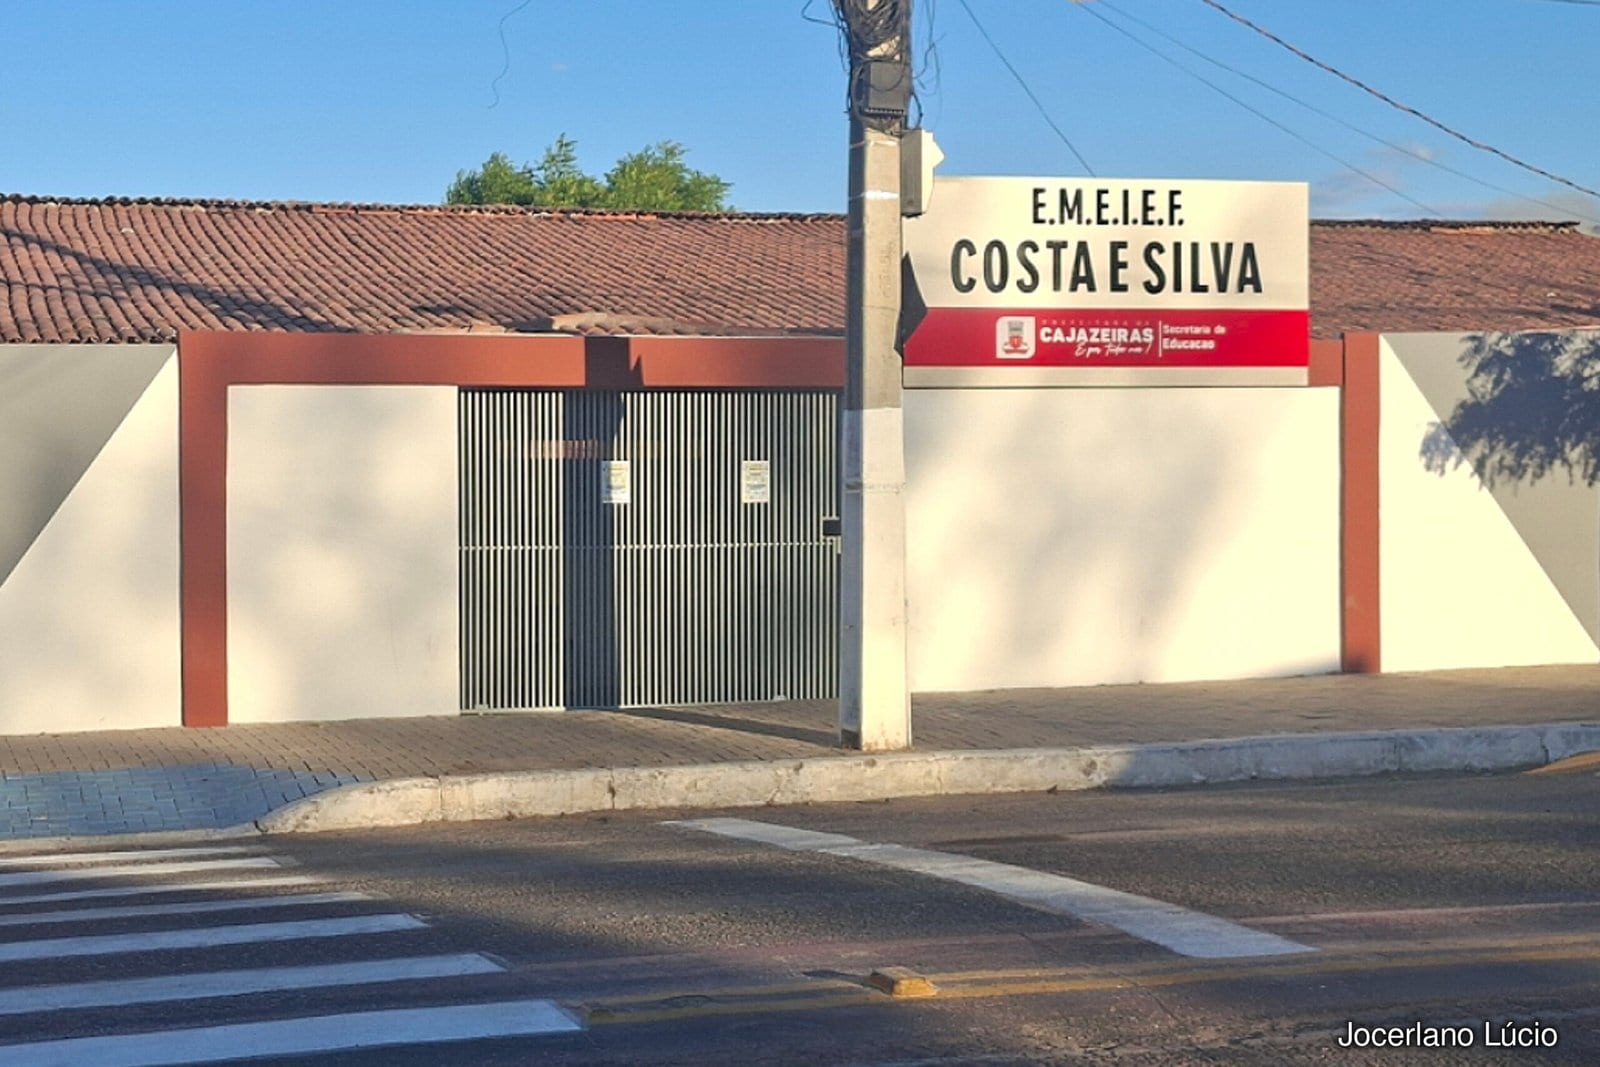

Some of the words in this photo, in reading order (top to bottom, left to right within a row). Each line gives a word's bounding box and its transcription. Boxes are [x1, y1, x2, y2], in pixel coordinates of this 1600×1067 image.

[1032, 188, 1184, 226] E.M.E.I.E.F.
[950, 238, 1097, 293] COSTA
[1109, 240, 1129, 292] E
[1142, 240, 1263, 295] SILVA
[1040, 326, 1154, 343] CAJAZEIRAS
